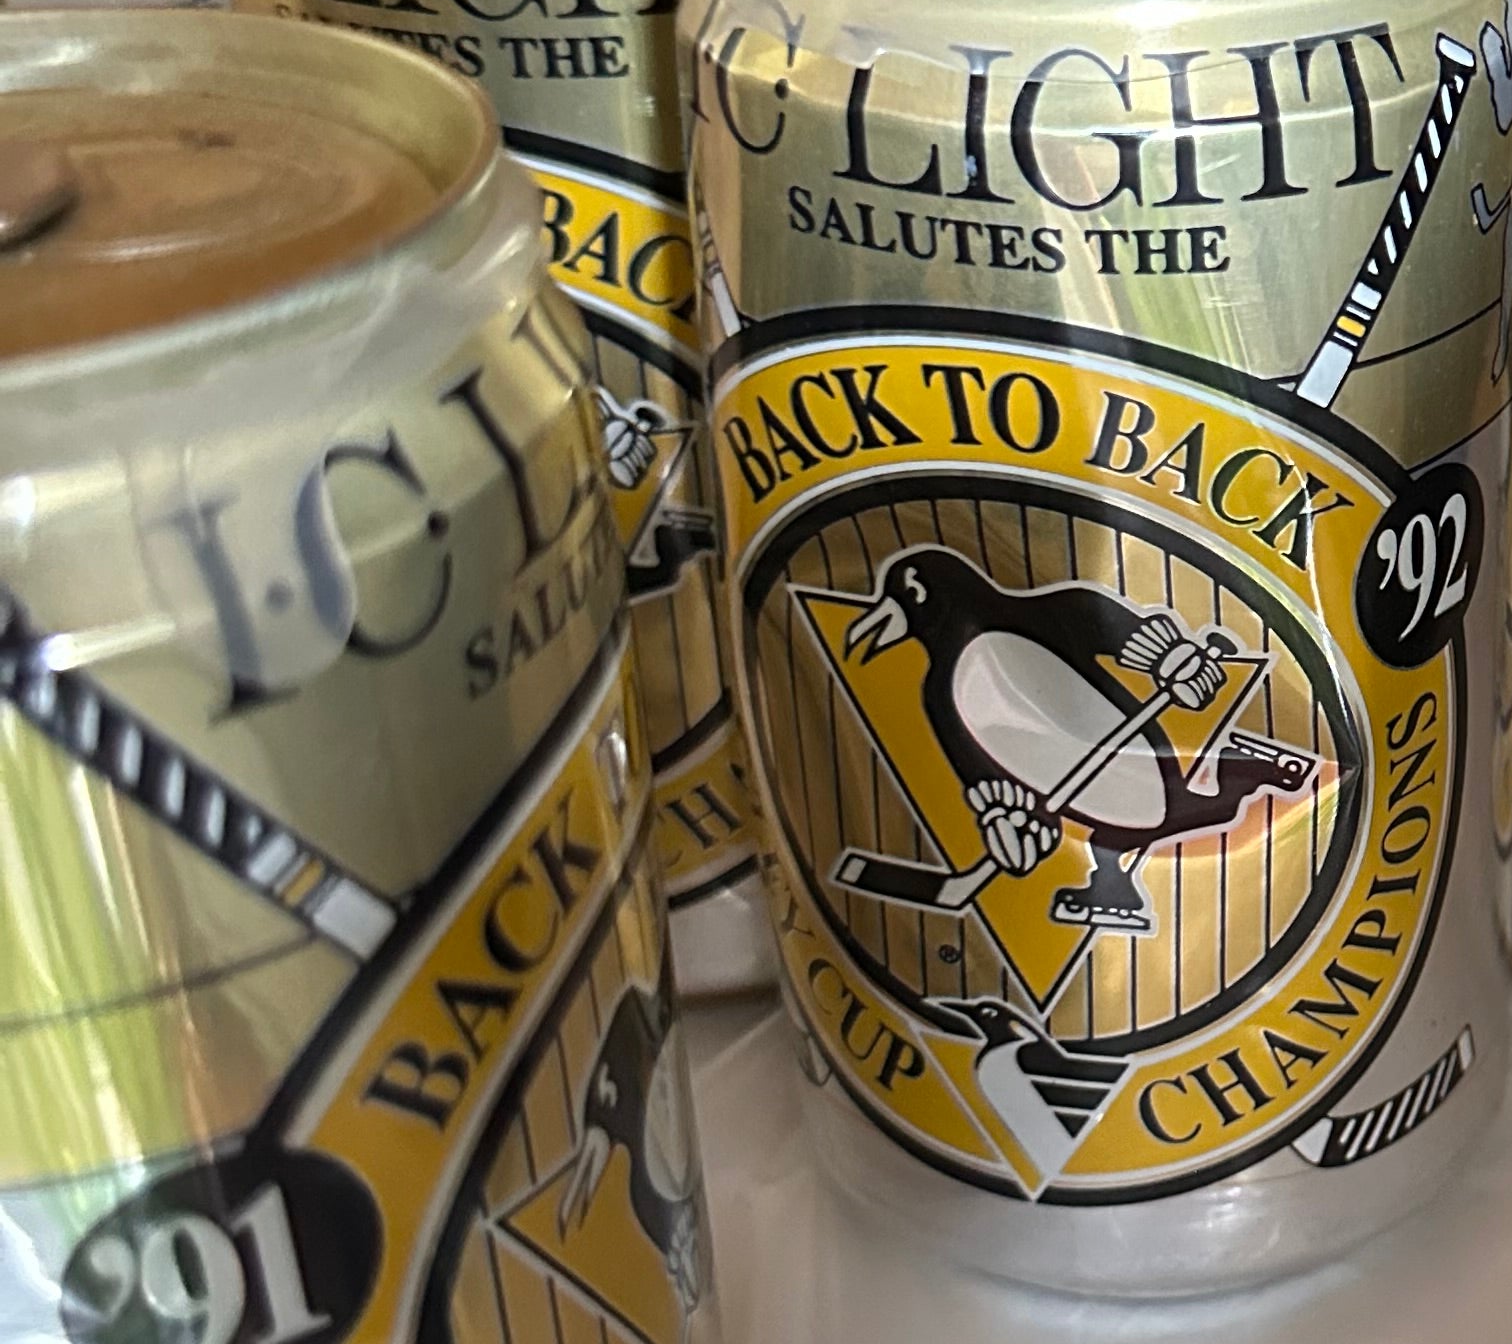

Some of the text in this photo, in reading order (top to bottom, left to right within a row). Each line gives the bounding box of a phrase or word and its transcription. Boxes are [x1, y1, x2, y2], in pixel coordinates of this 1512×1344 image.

[502, 34, 631, 80] THE
[831, 21, 1408, 211] LIGHT
[540, 186, 698, 322] BAC
[787, 185, 1232, 277] SALUTES THE
[722, 362, 1356, 572] BACK TO BACK
[364, 791, 603, 1135] BACK
[1137, 687, 1440, 1147] CHAMPIONS
[807, 957, 926, 1092] CUP
